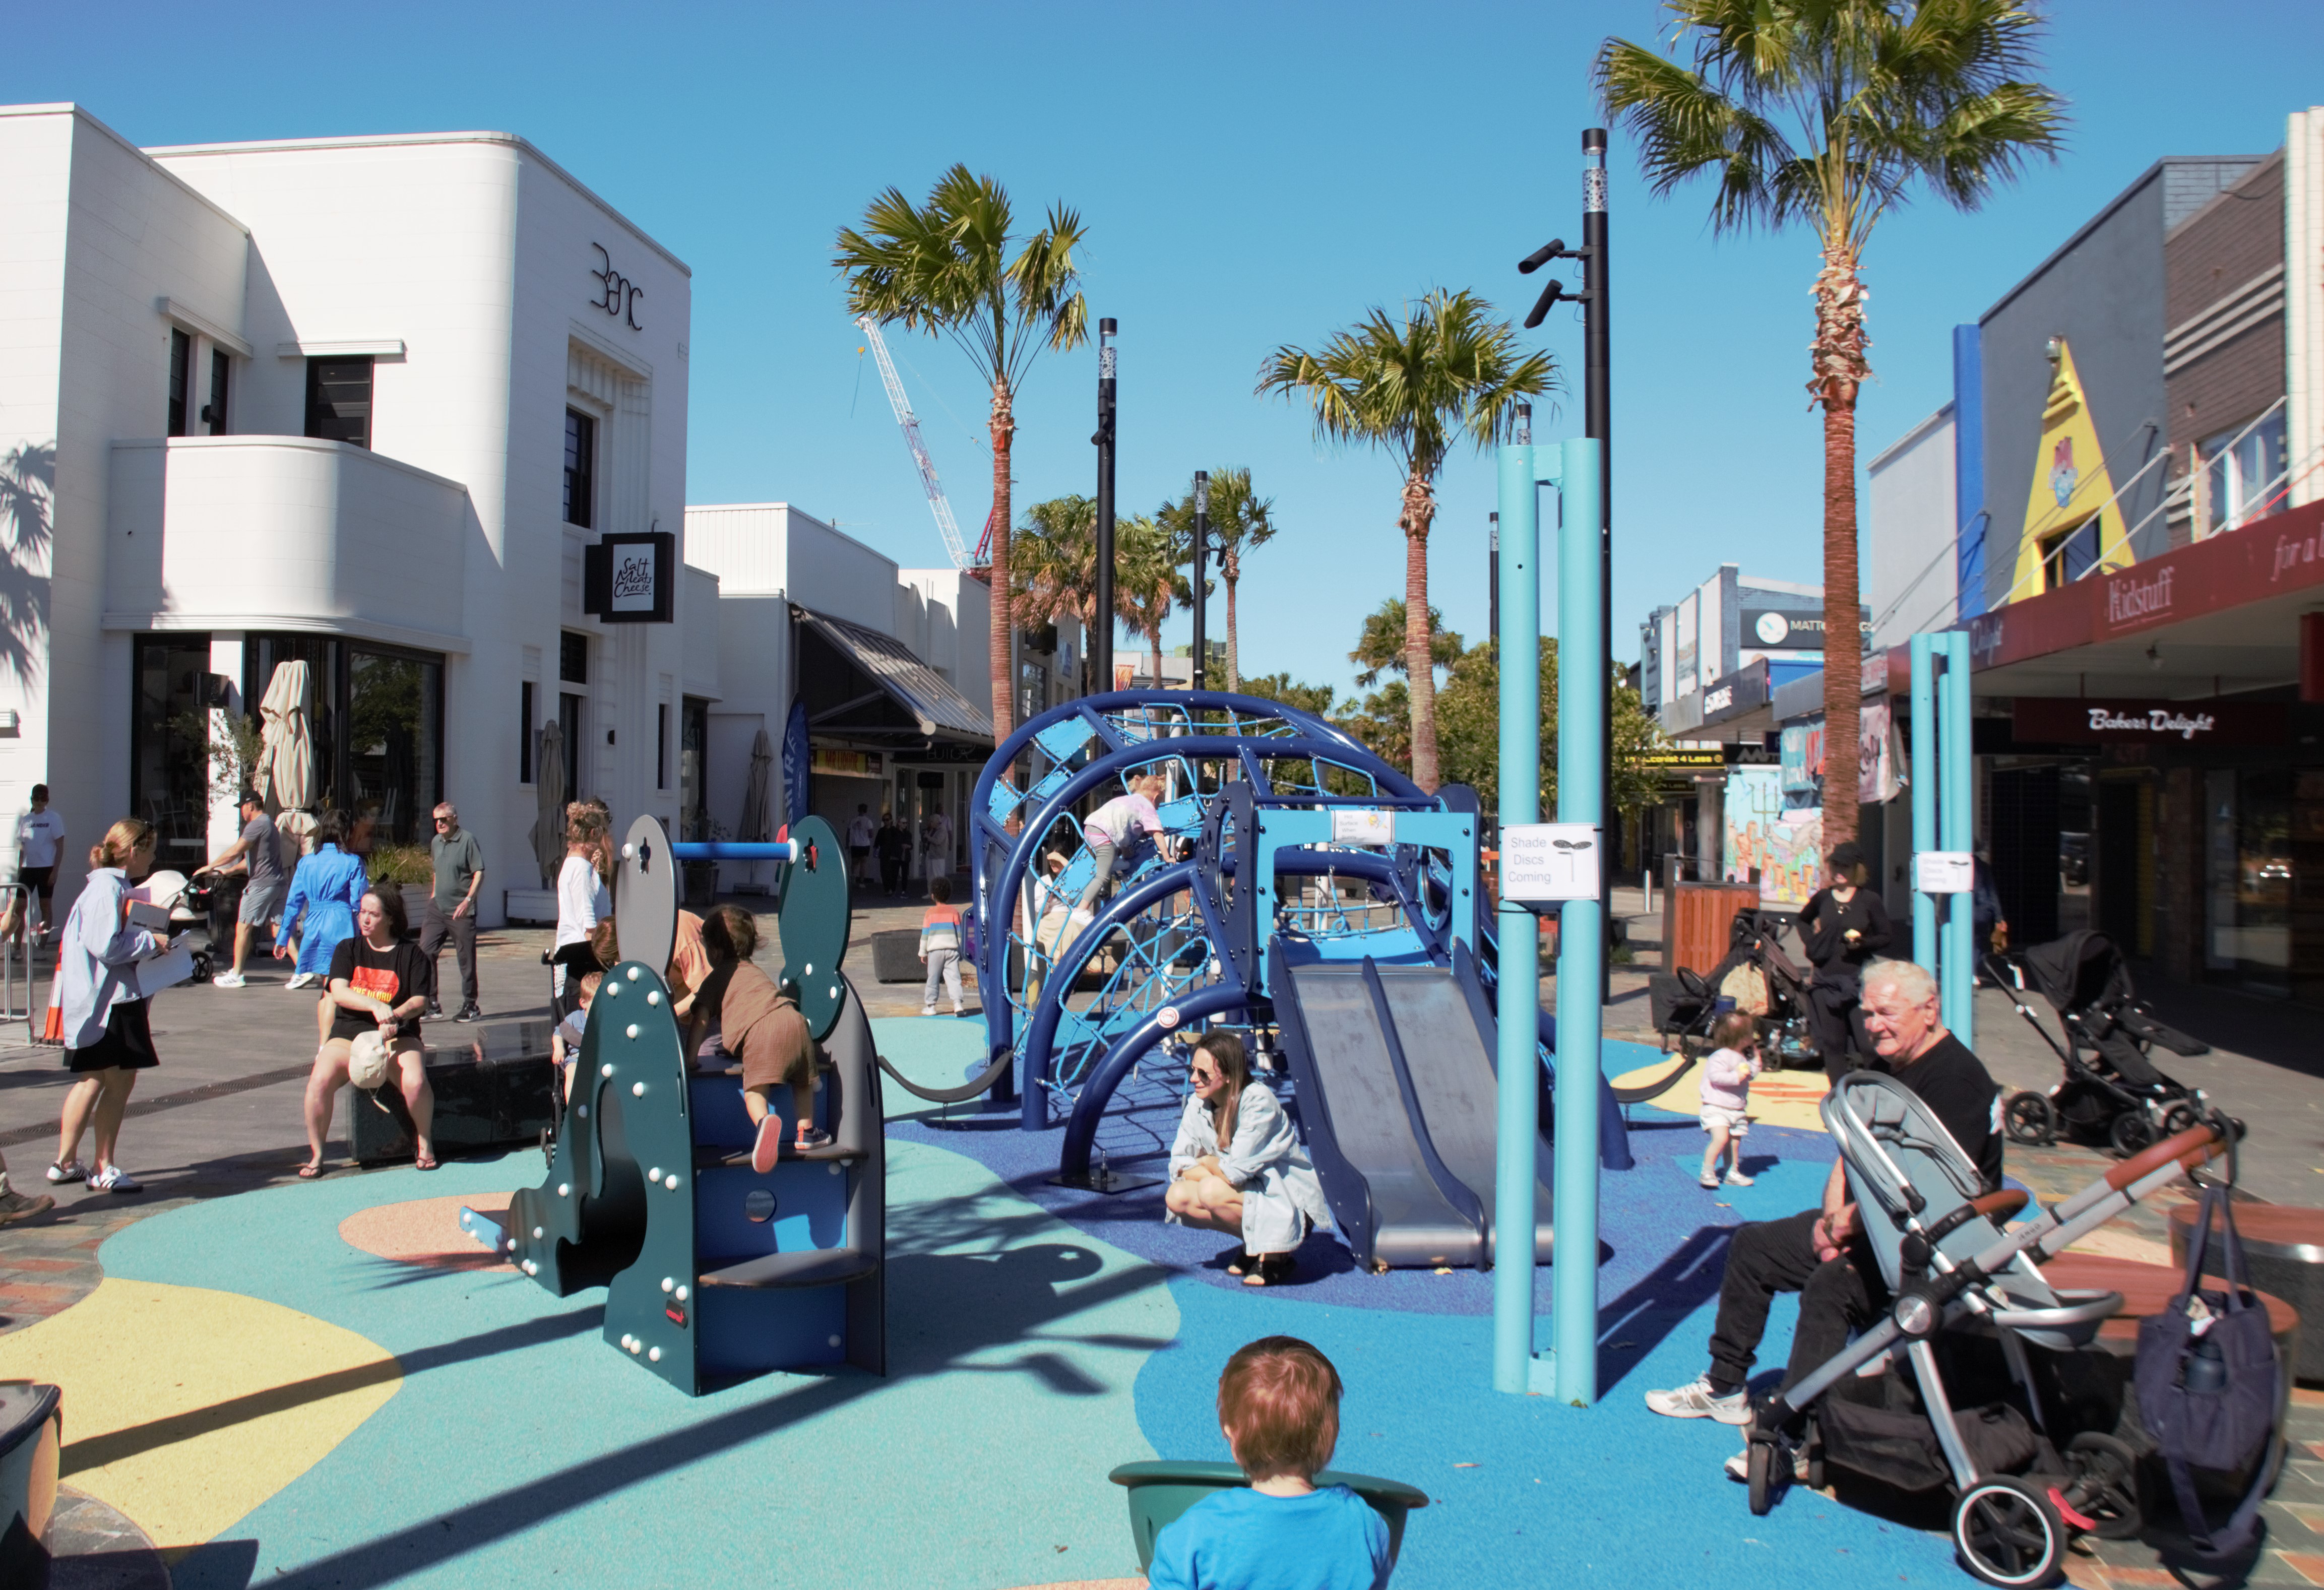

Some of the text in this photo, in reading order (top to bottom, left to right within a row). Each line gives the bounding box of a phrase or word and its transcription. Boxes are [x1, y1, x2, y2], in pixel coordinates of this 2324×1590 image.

[2270, 534, 2301, 582] for
[622, 557, 651, 577] Salt
[615, 569, 652, 584] Meats
[2108, 565, 2175, 623] Kidstuff
[2088, 708, 2215, 740] Bakers Delight
[1511, 837, 1547, 849] Shade
[1514, 854, 1544, 865] Discs
[1508, 871, 1551, 884] Coming
[353, 986, 366, 995] THE
